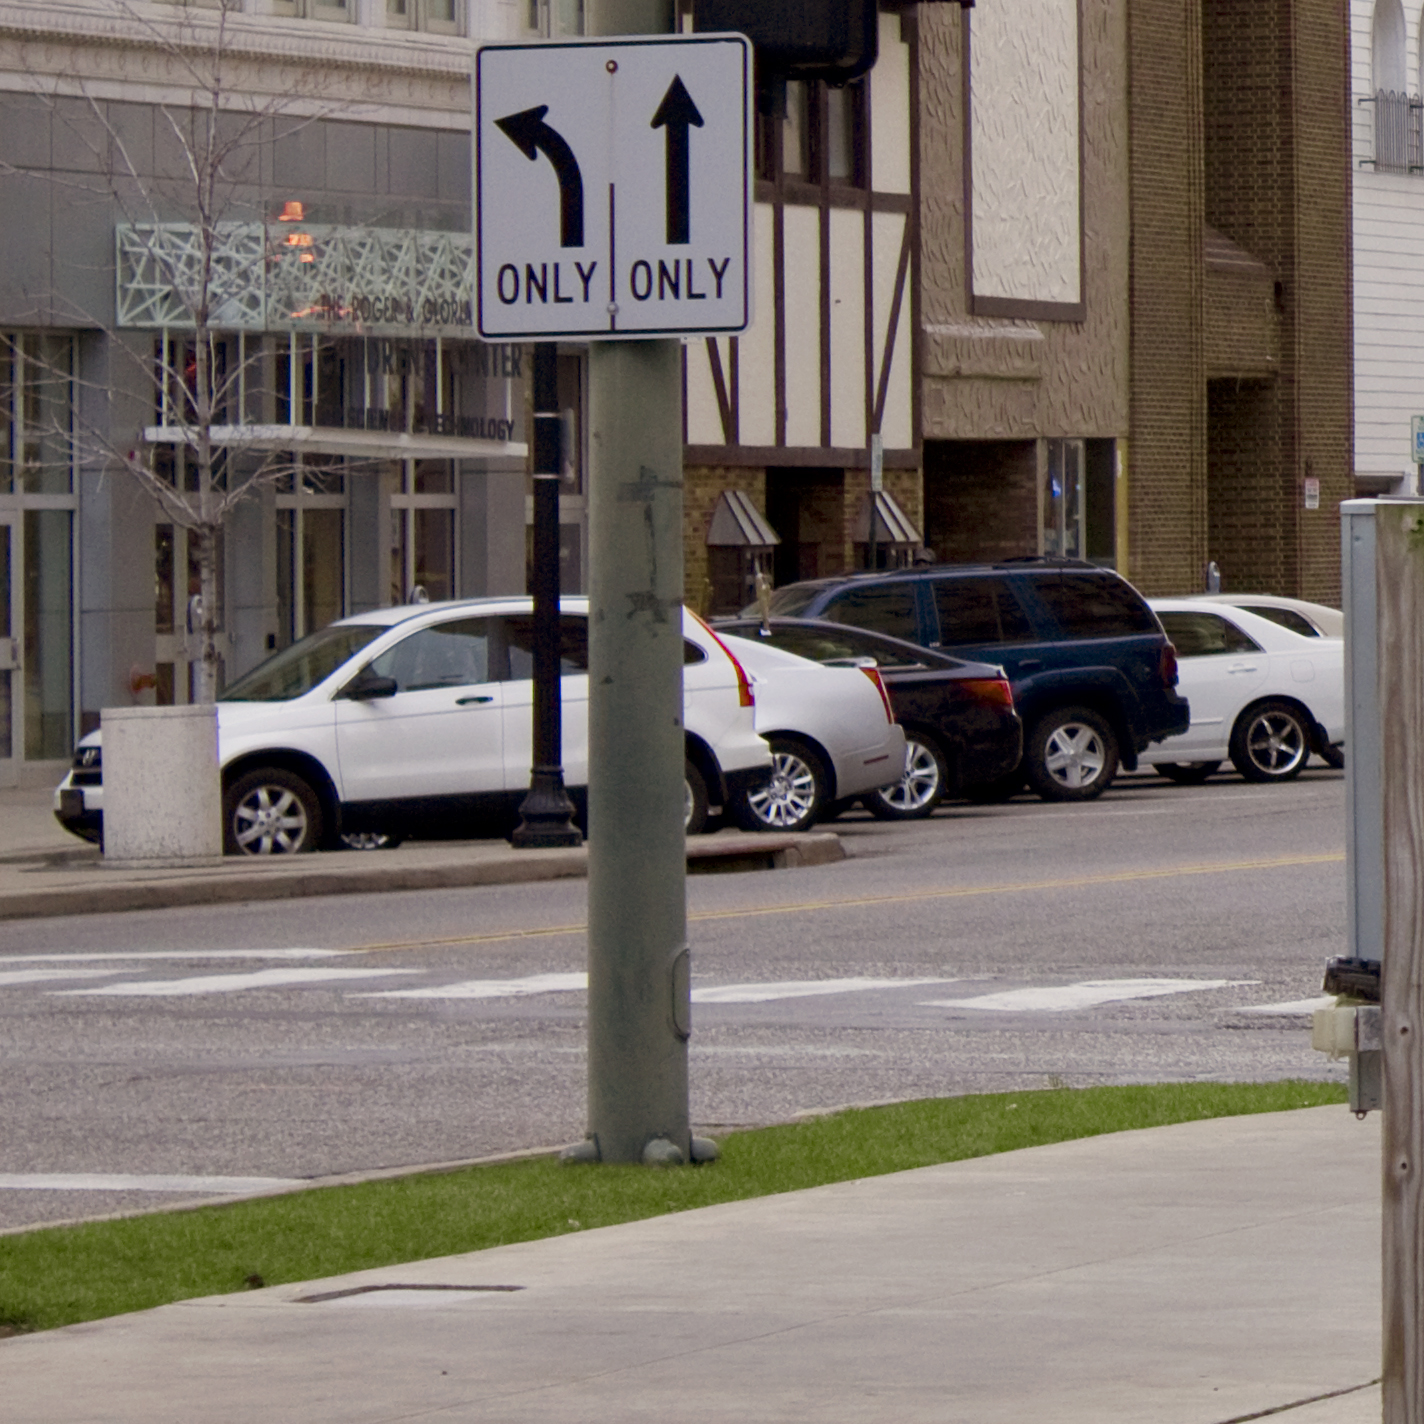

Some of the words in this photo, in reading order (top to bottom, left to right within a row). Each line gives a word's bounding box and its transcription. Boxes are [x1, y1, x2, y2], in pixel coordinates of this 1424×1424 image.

[497, 261, 597, 305] ONLY
[630, 257, 730, 302] ONLY
[352, 295, 399, 323] ROGER
